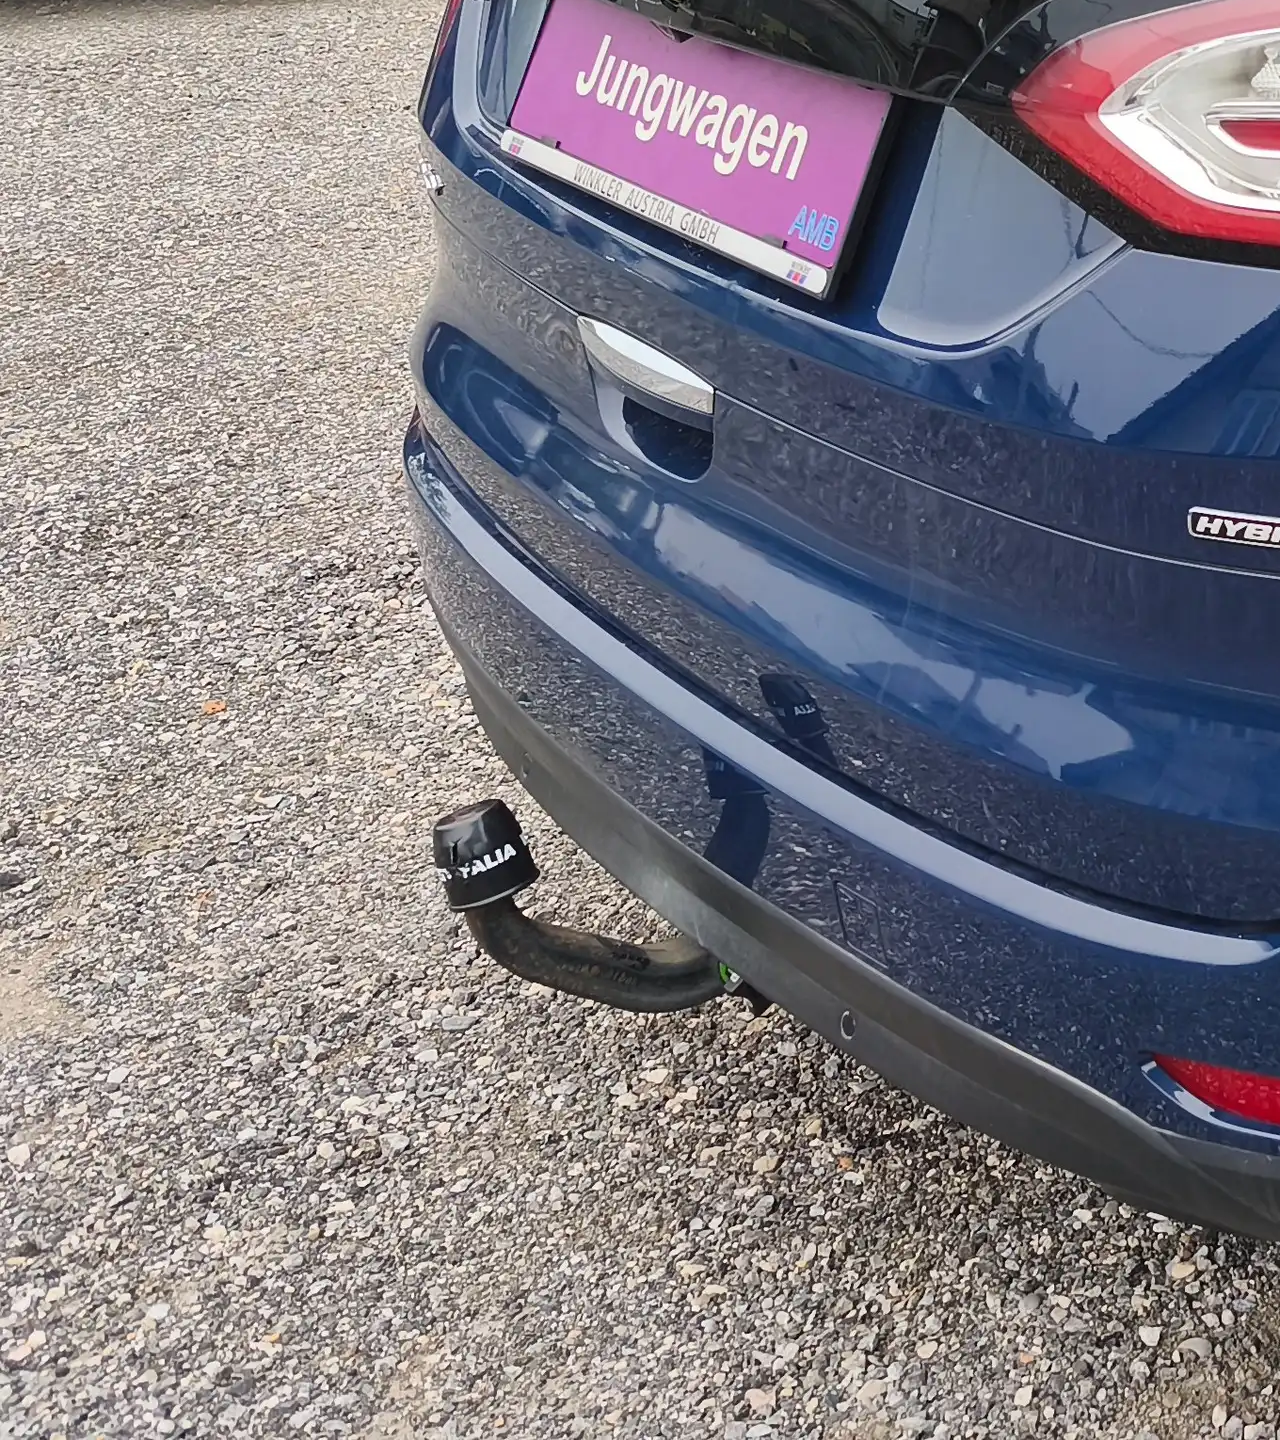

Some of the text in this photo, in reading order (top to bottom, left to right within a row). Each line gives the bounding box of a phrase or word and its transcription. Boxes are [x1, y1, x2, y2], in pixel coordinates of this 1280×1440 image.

[576, 34, 809, 181] Jungwagen
[573, 163, 721, 244] WINKLER AUSTRIA GMBH
[787, 204, 840, 252] AMB
